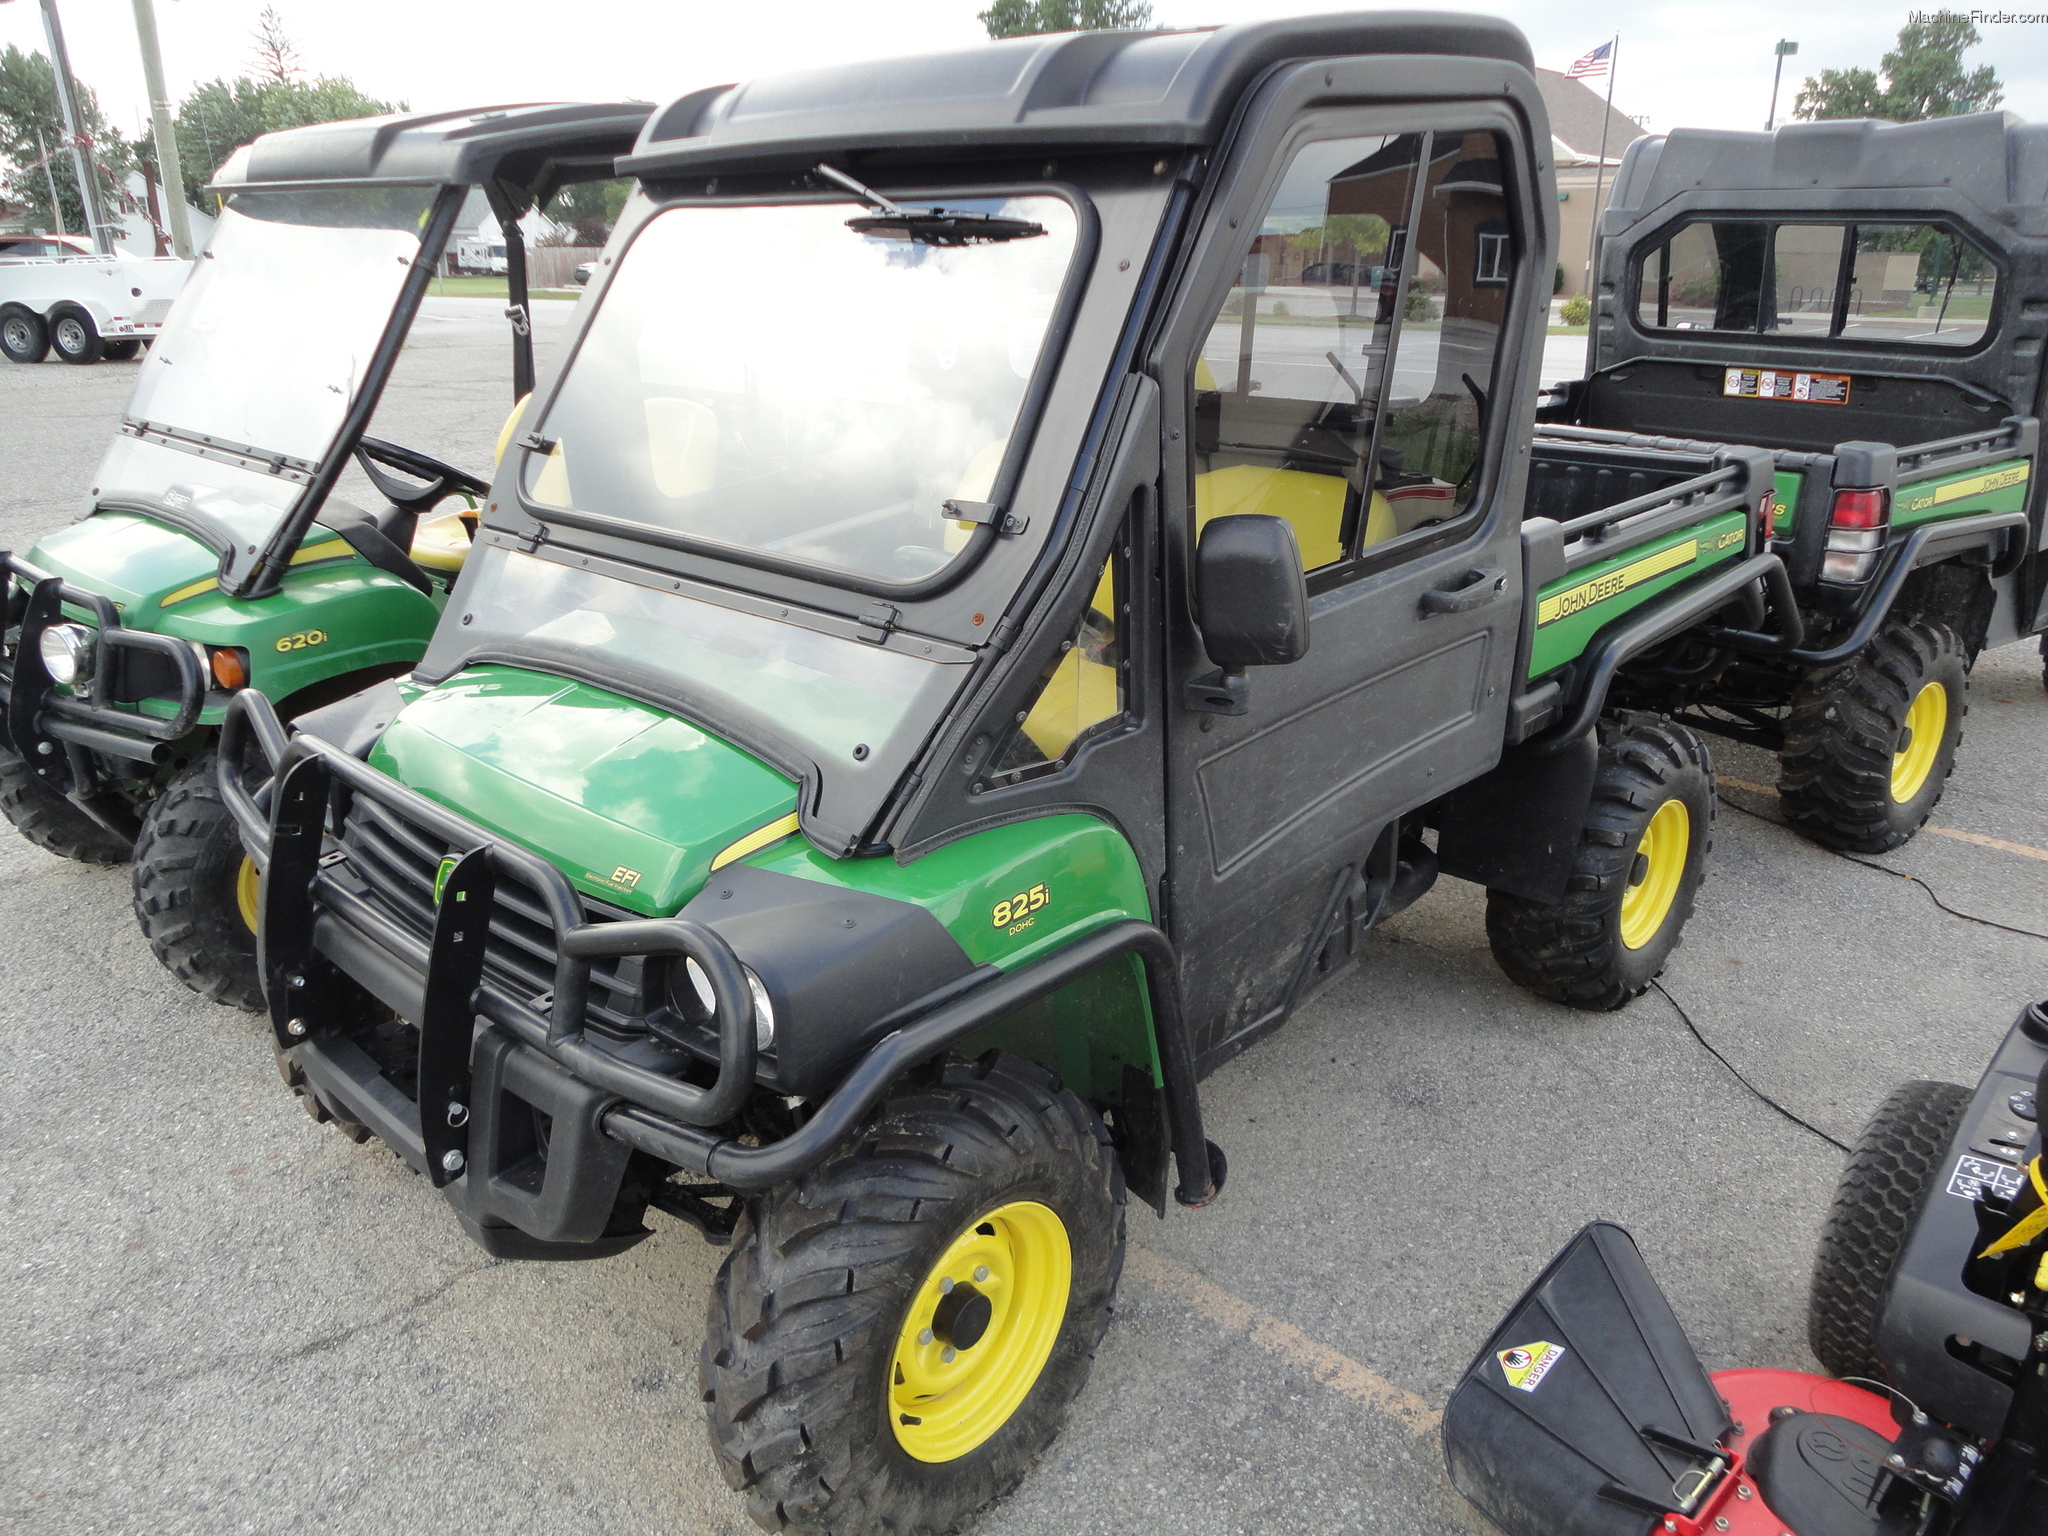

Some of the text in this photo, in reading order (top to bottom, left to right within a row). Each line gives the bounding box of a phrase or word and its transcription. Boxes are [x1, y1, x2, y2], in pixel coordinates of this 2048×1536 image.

[1981, 471, 2020, 493] JOHN DEERE
[1718, 528, 1744, 550] GATOR
[1555, 574, 1625, 619] JOHN DEERE
[275, 629, 328, 653] 620i
[610, 865, 642, 888] EFI
[992, 882, 1050, 929] 825i
[1009, 917, 1035, 936] DOHC
[1524, 1348, 1558, 1387] DANGER
